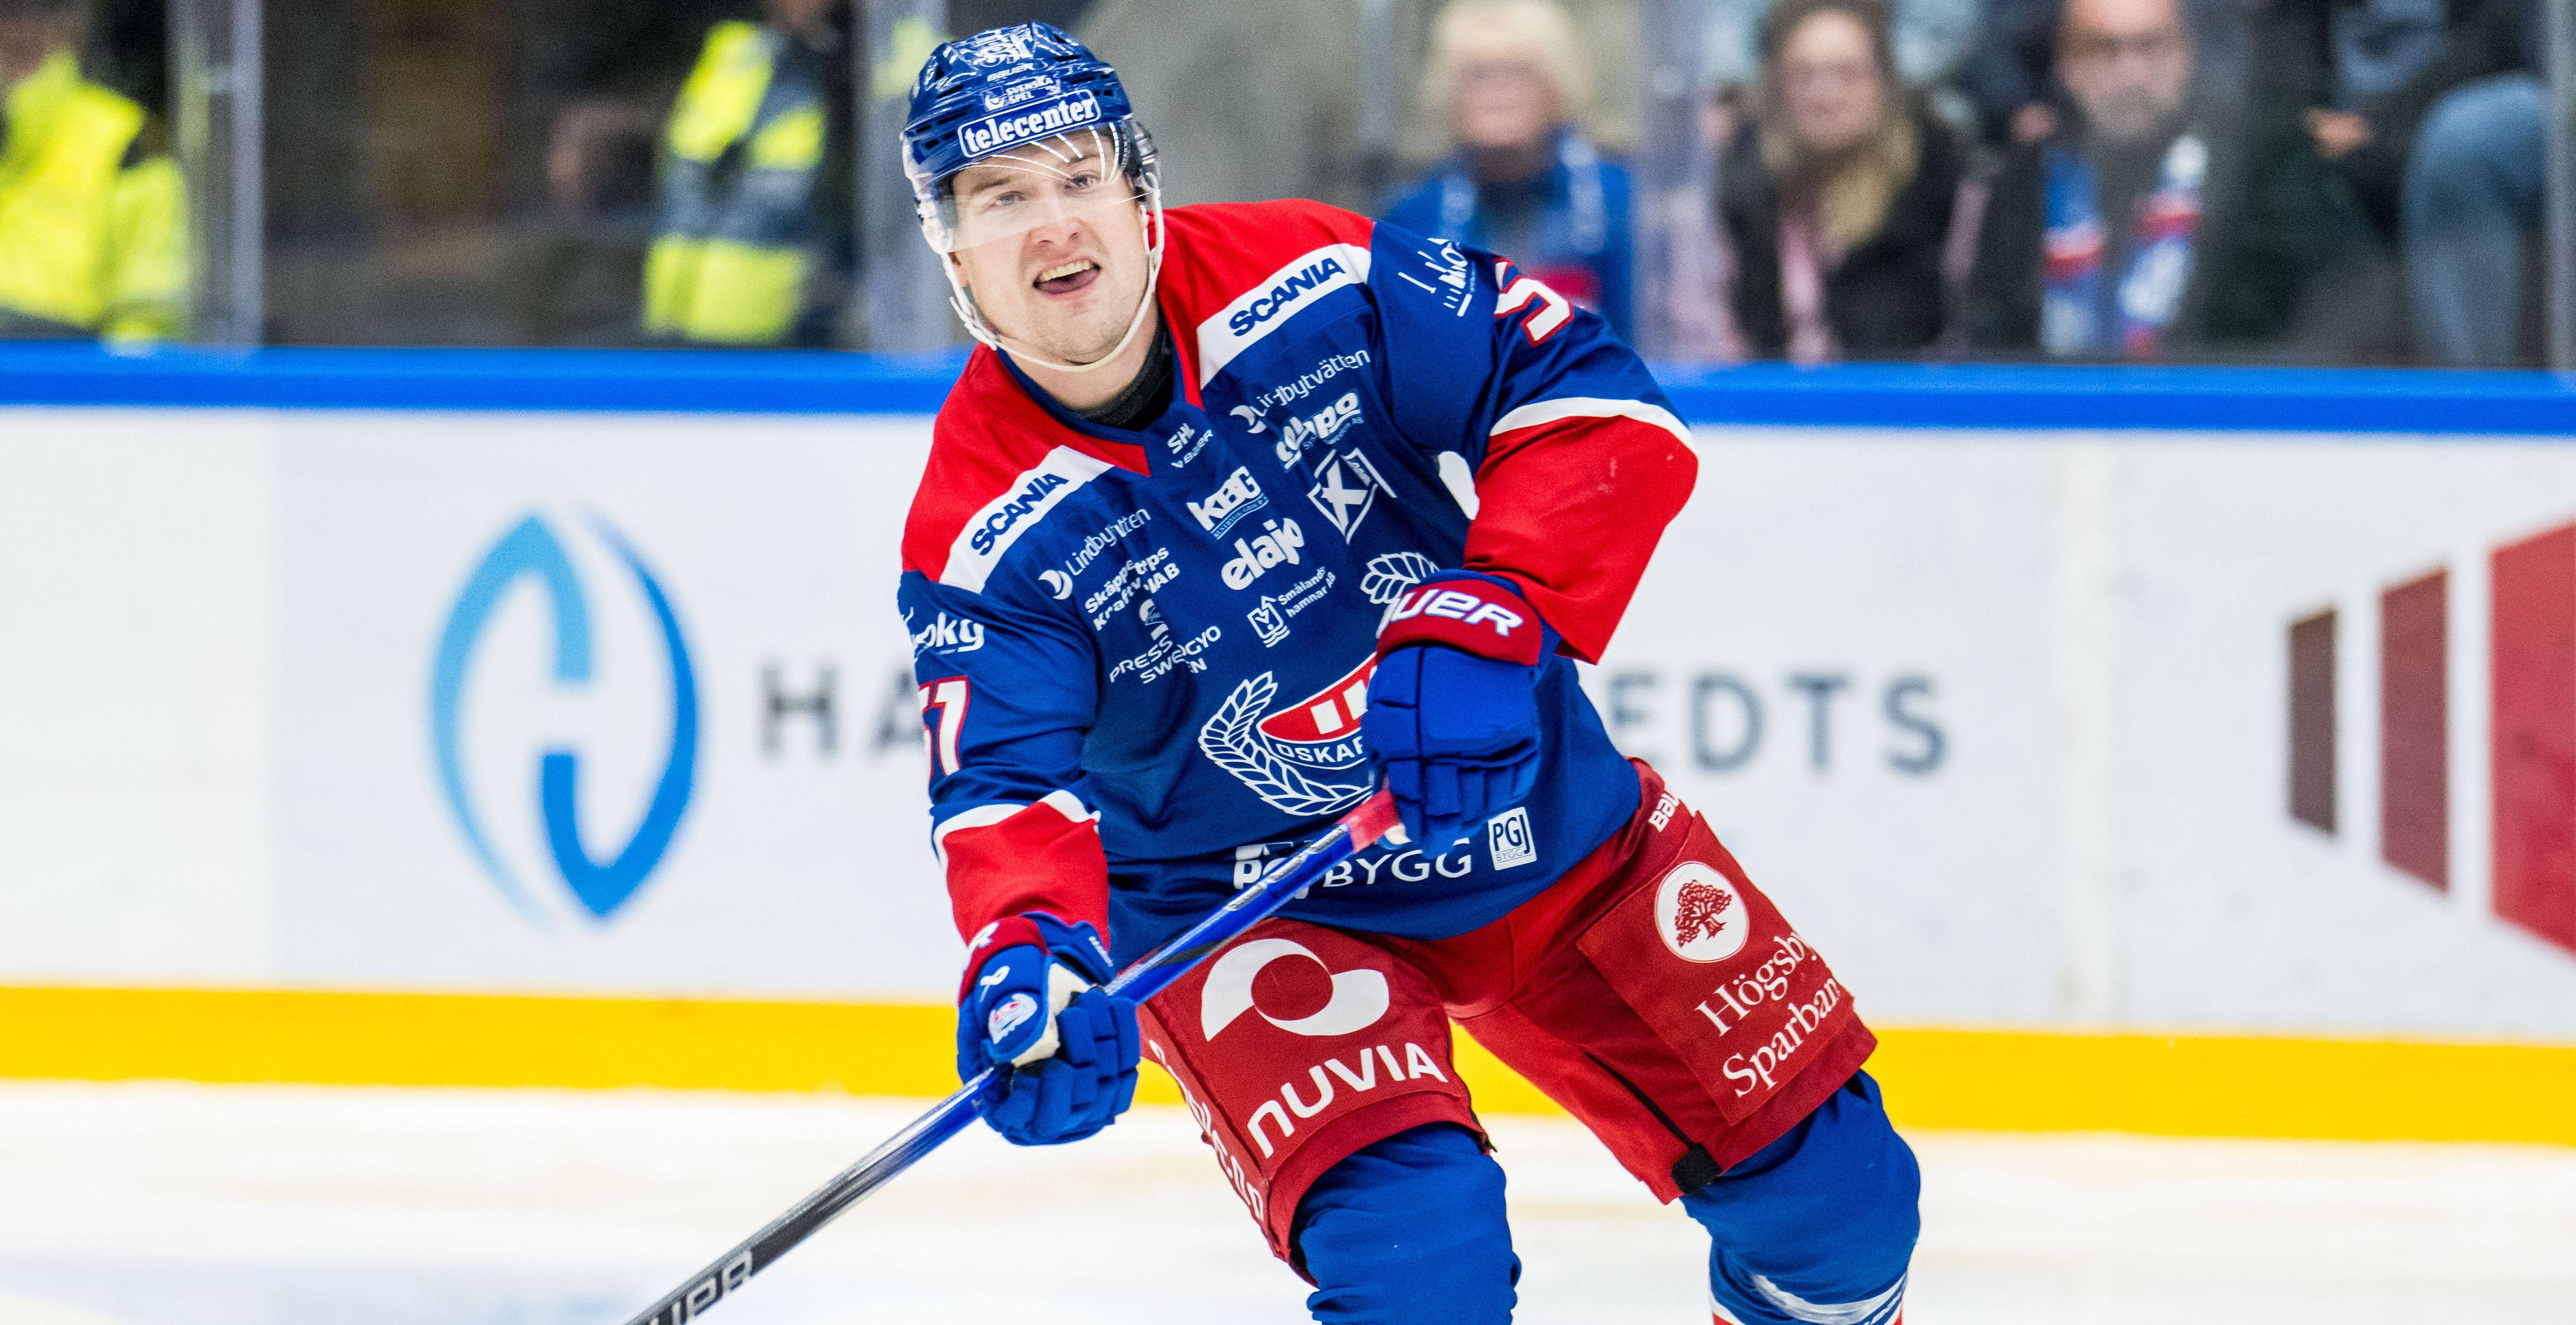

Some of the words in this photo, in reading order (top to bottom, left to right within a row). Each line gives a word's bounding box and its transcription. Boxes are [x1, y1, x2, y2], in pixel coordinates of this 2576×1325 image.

[1008, 91, 1035, 105] SPEL
[964, 98, 1095, 153] telecenter
[1229, 257, 1346, 337] SCANIA
[971, 473, 1069, 556] SCANIA
[1186, 466, 1261, 531] KBG
[1221, 518, 1305, 590] elajo
[1286, 586, 1328, 617] hamnar
[1109, 635, 1173, 683] PRESS
[1493, 814, 1530, 854] PGJ
[1496, 849, 1522, 861] BYGG
[1323, 838, 1472, 888] BYGG
